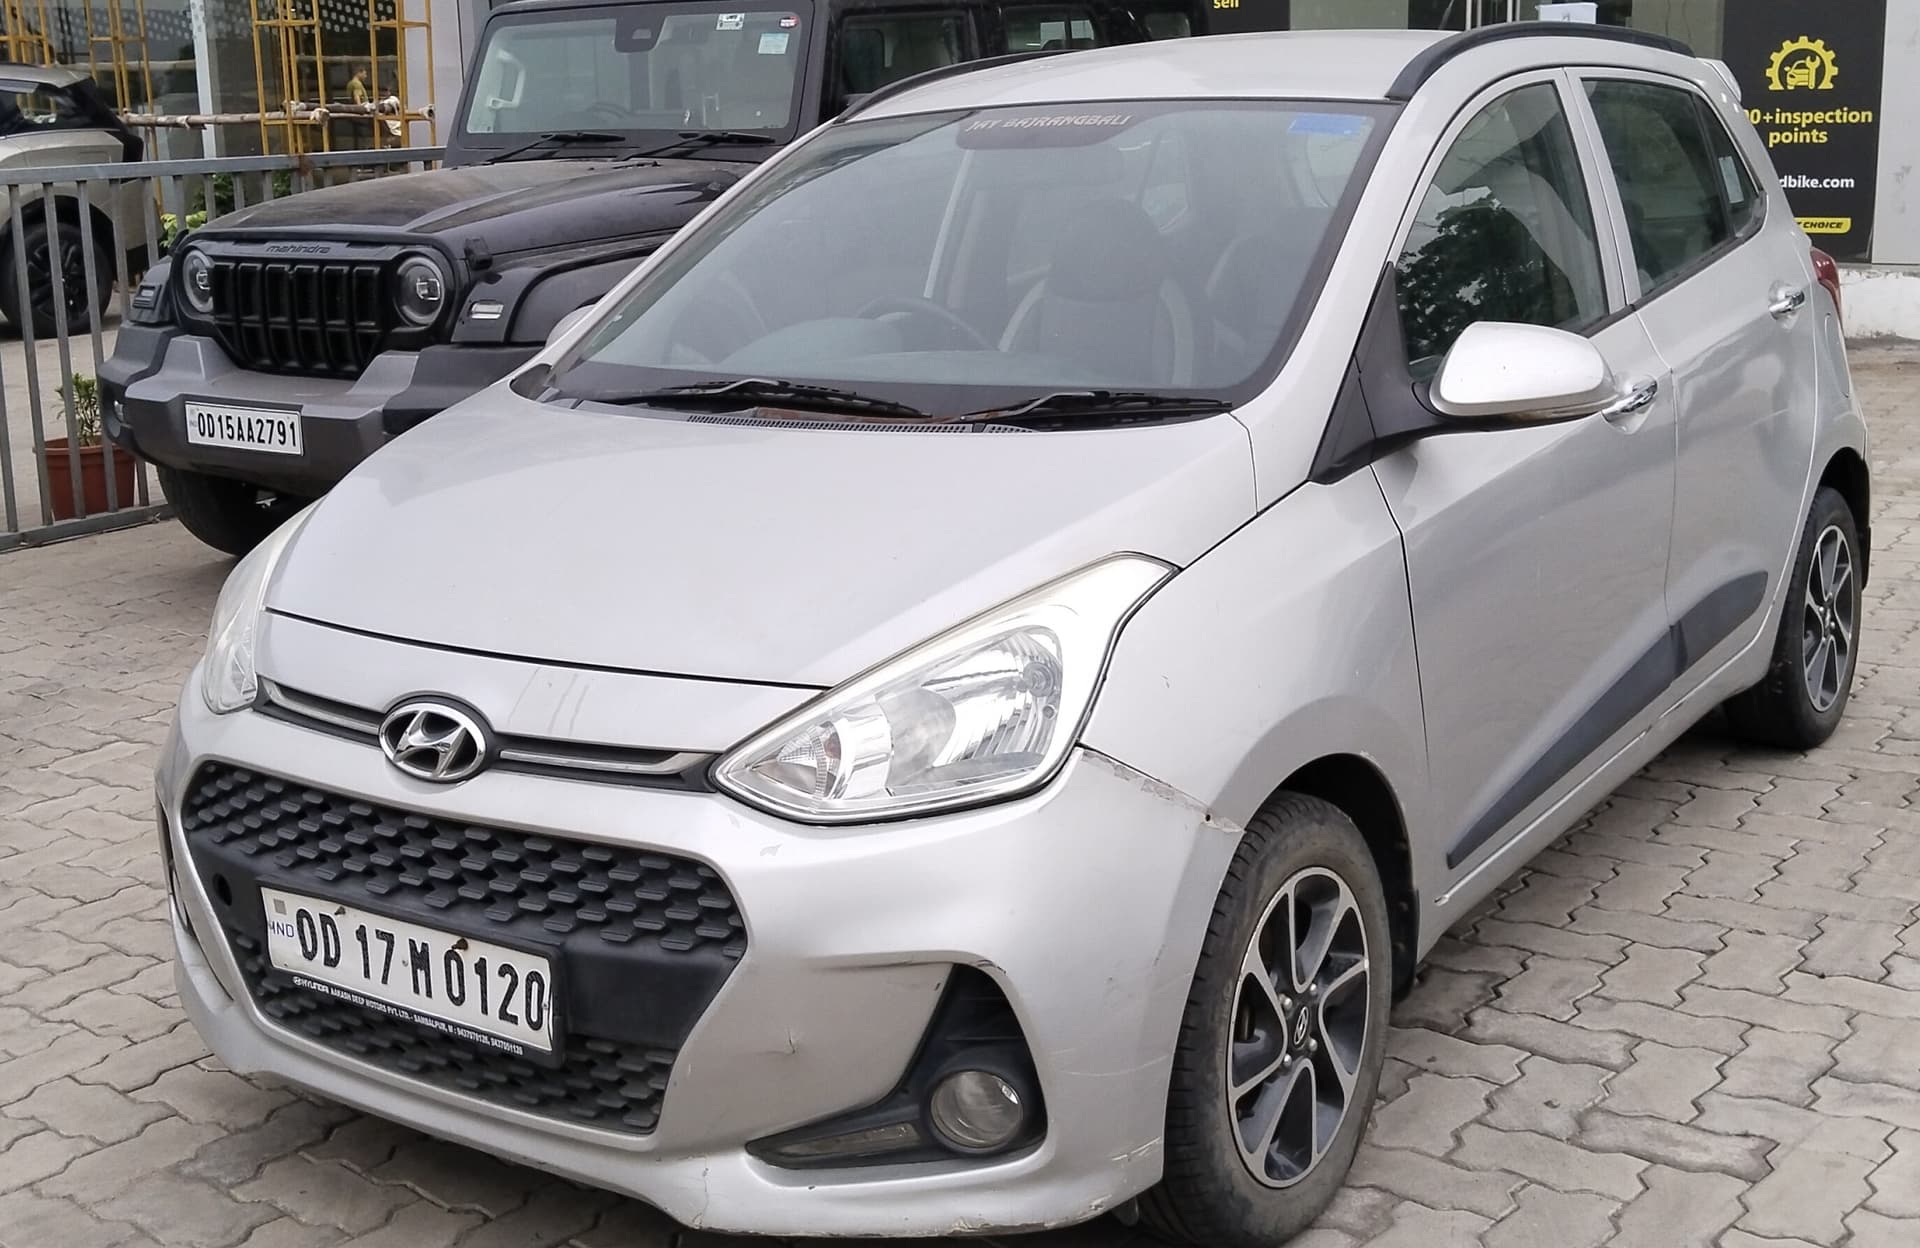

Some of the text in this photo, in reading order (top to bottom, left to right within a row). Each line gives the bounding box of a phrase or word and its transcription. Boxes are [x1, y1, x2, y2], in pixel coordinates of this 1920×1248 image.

[966, 114, 1133, 132] JAY BAJRANGBALI
[1768, 127, 1828, 148] points
[1802, 221, 1844, 229] CHOICE
[266, 244, 331, 254] mahindra
[198, 412, 296, 447] OD15AA2791
[355, 924, 395, 985] 17
[408, 938, 433, 999] M
[444, 949, 546, 1031] 0120
